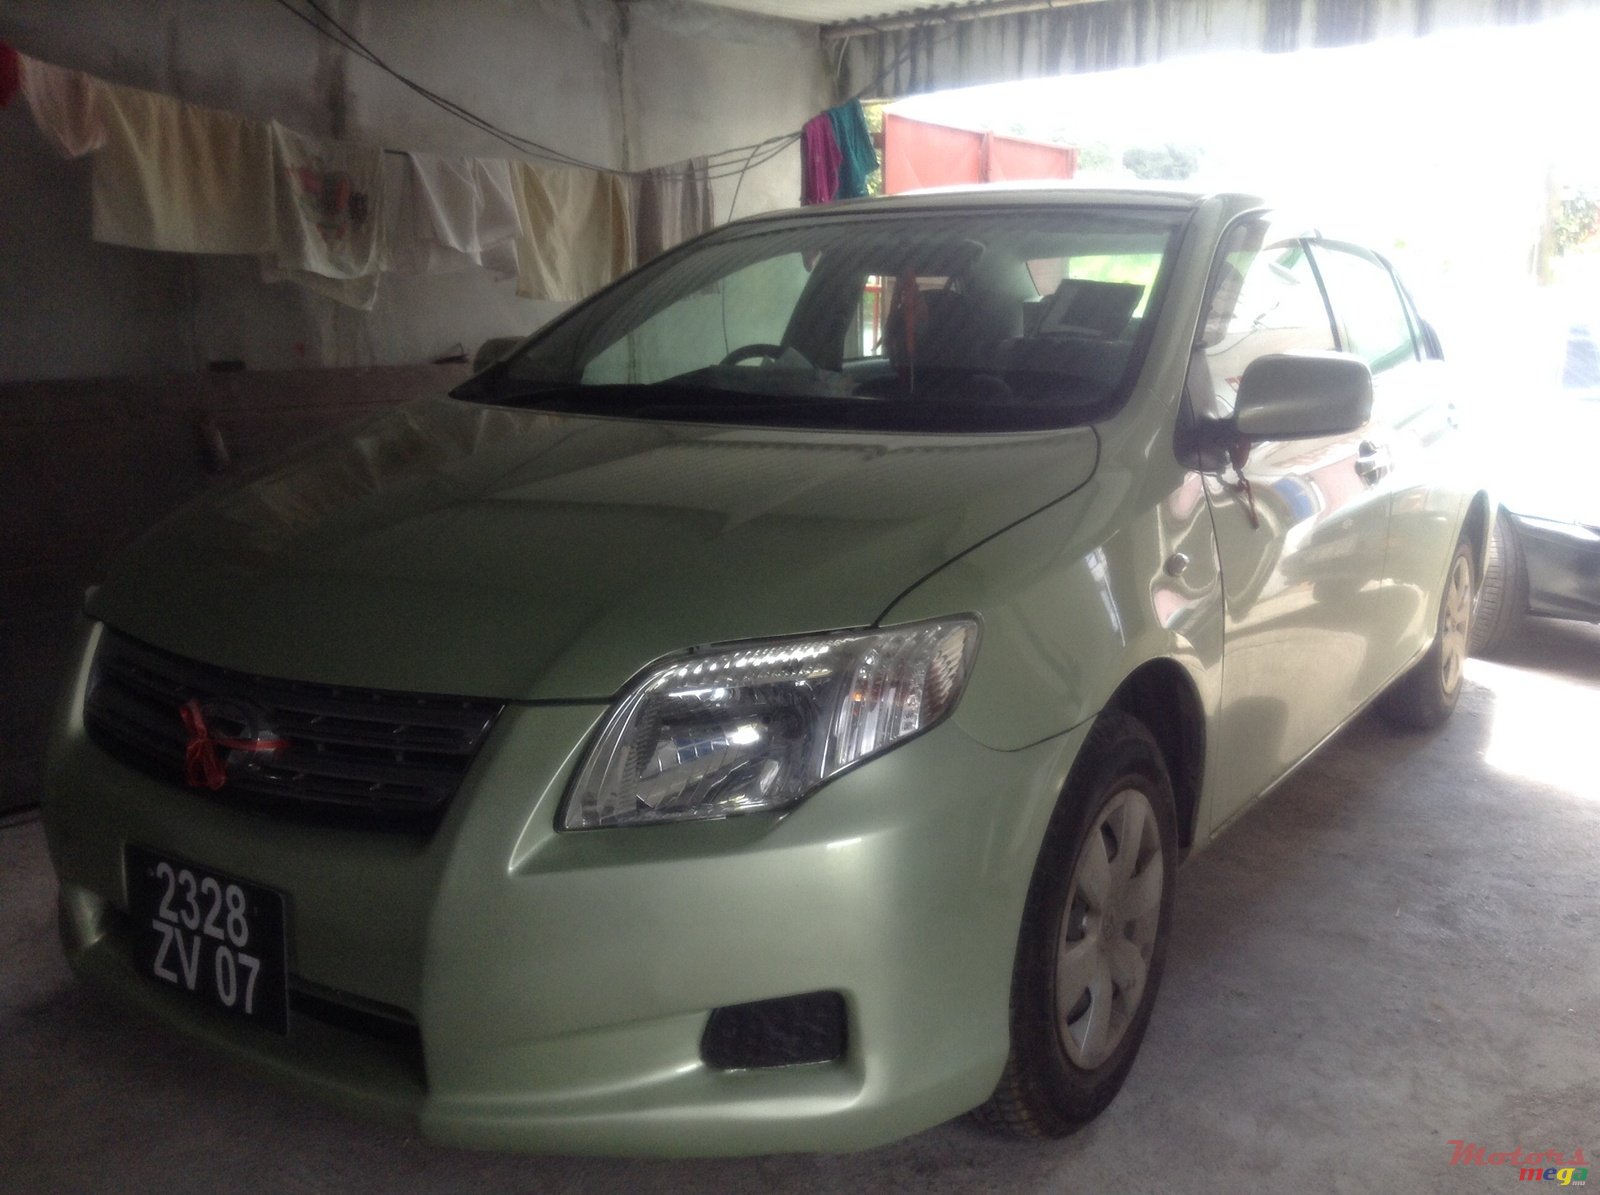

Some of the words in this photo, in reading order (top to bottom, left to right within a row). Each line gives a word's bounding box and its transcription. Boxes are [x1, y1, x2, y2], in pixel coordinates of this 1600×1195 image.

[156, 862, 249, 948] 2328
[152, 918, 202, 991] ZV
[214, 945, 261, 1015] 07
